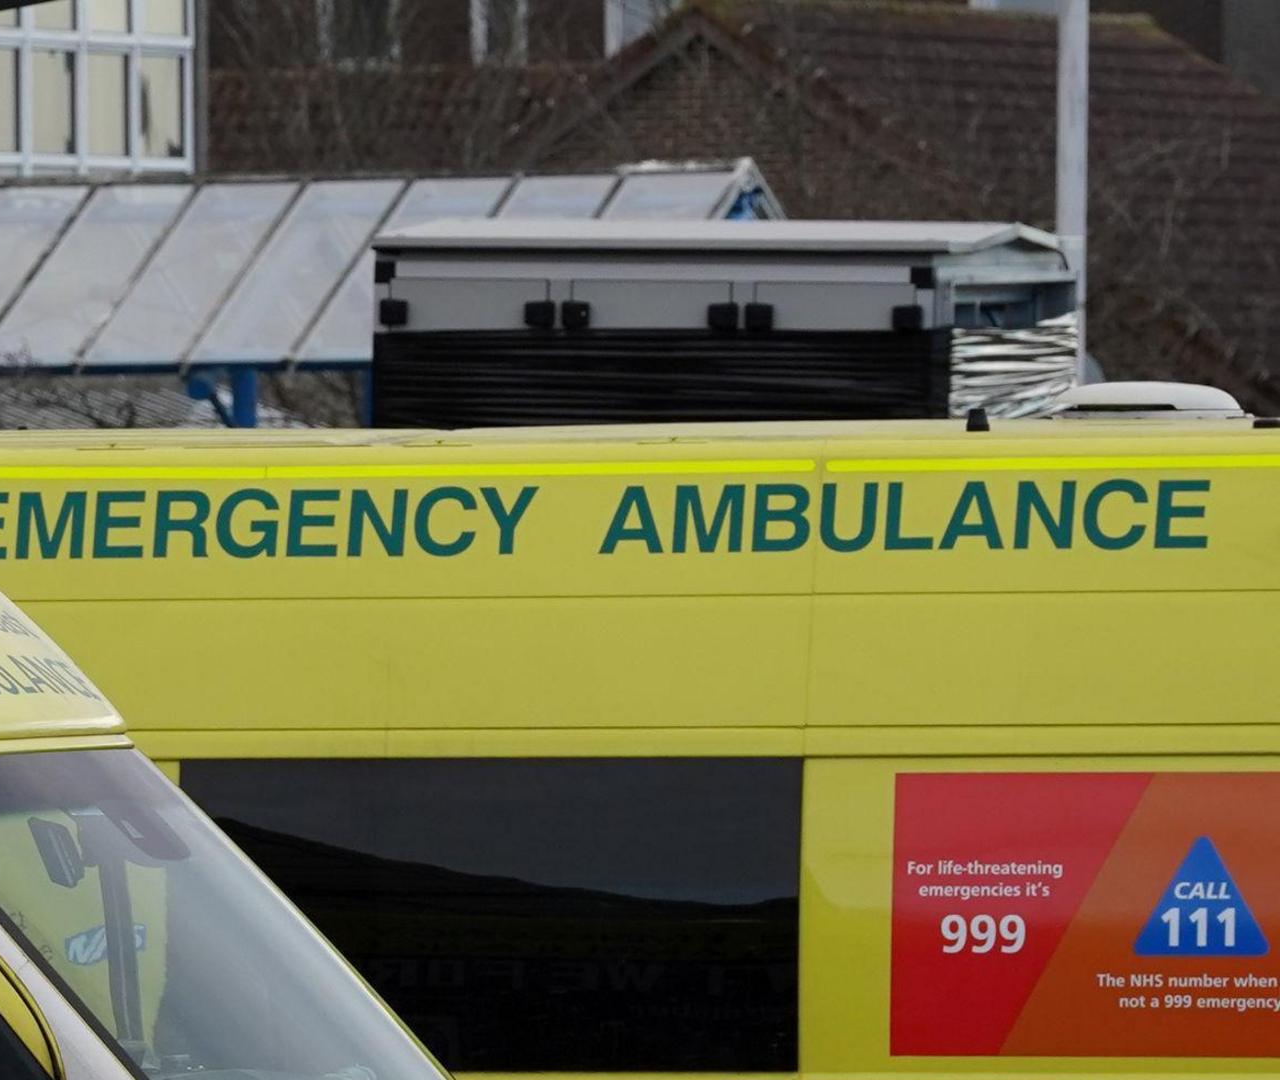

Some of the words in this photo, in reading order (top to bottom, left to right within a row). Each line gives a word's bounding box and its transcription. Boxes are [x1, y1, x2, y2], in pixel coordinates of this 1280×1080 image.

[598, 479, 1211, 554] AMBULANCE
[907, 861, 933, 875] For
[938, 860, 1063, 878] life-threatening
[918, 883, 1021, 900] emergencies
[1174, 882, 1231, 899] CALL
[940, 914, 1026, 954] 999
[1161, 907, 1236, 947] 111
[1097, 973, 1125, 988] The
[1130, 973, 1163, 988] NHS
[1168, 973, 1229, 988] number
[1233, 973, 1278, 988] when
[1119, 995, 1146, 1009] not
[1150, 997, 1159, 1009] a
[1164, 994, 1192, 1009] 999
